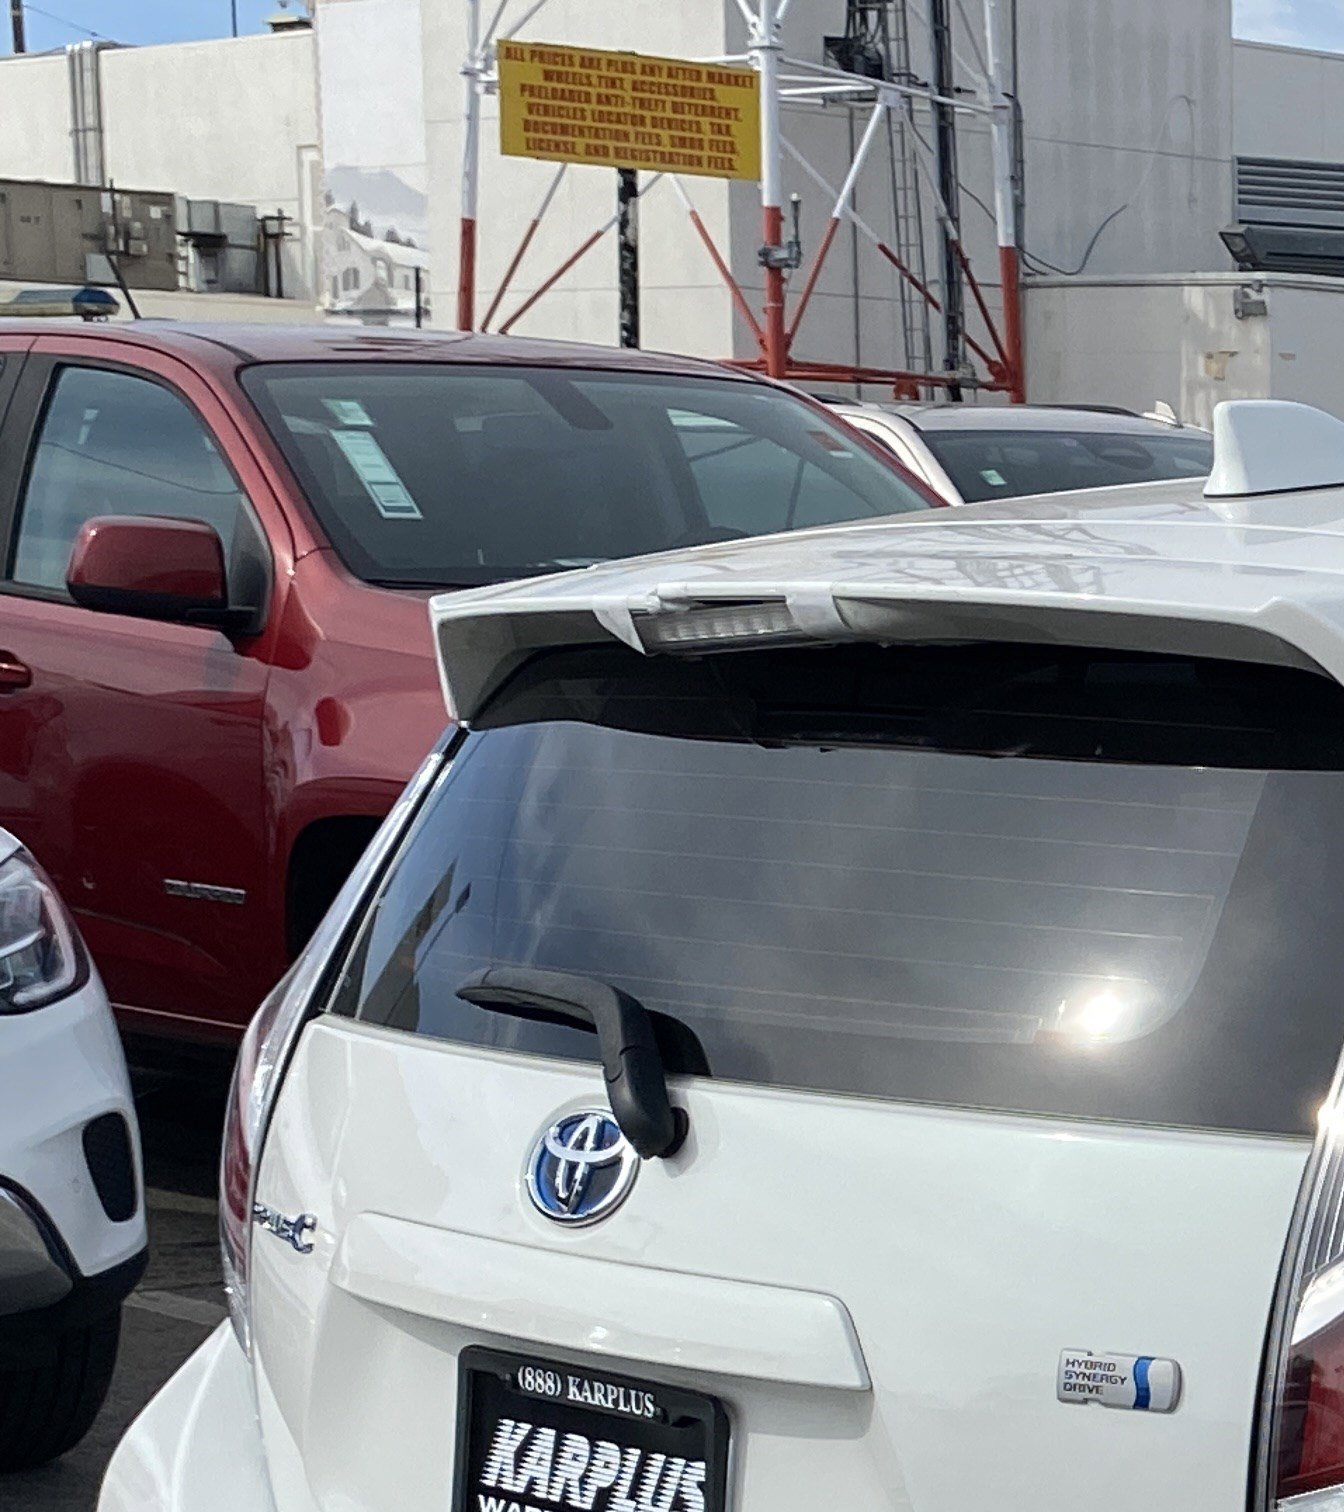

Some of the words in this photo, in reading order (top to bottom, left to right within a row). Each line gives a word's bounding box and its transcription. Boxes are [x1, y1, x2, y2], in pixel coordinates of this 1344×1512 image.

[504, 46, 524, 62] ALL
[529, 49, 575, 68] PRICES
[579, 55, 602, 71] ARE
[666, 65, 702, 83] AFTER
[705, 70, 754, 89] MARKET
[1065, 1358, 1116, 1372] HYBRID
[1064, 1370, 1127, 1386] SYNERGY
[517, 1365, 562, 1396] (888)
[567, 1375, 656, 1418] KARPLUS
[1063, 1382, 1103, 1395] DRIVE
